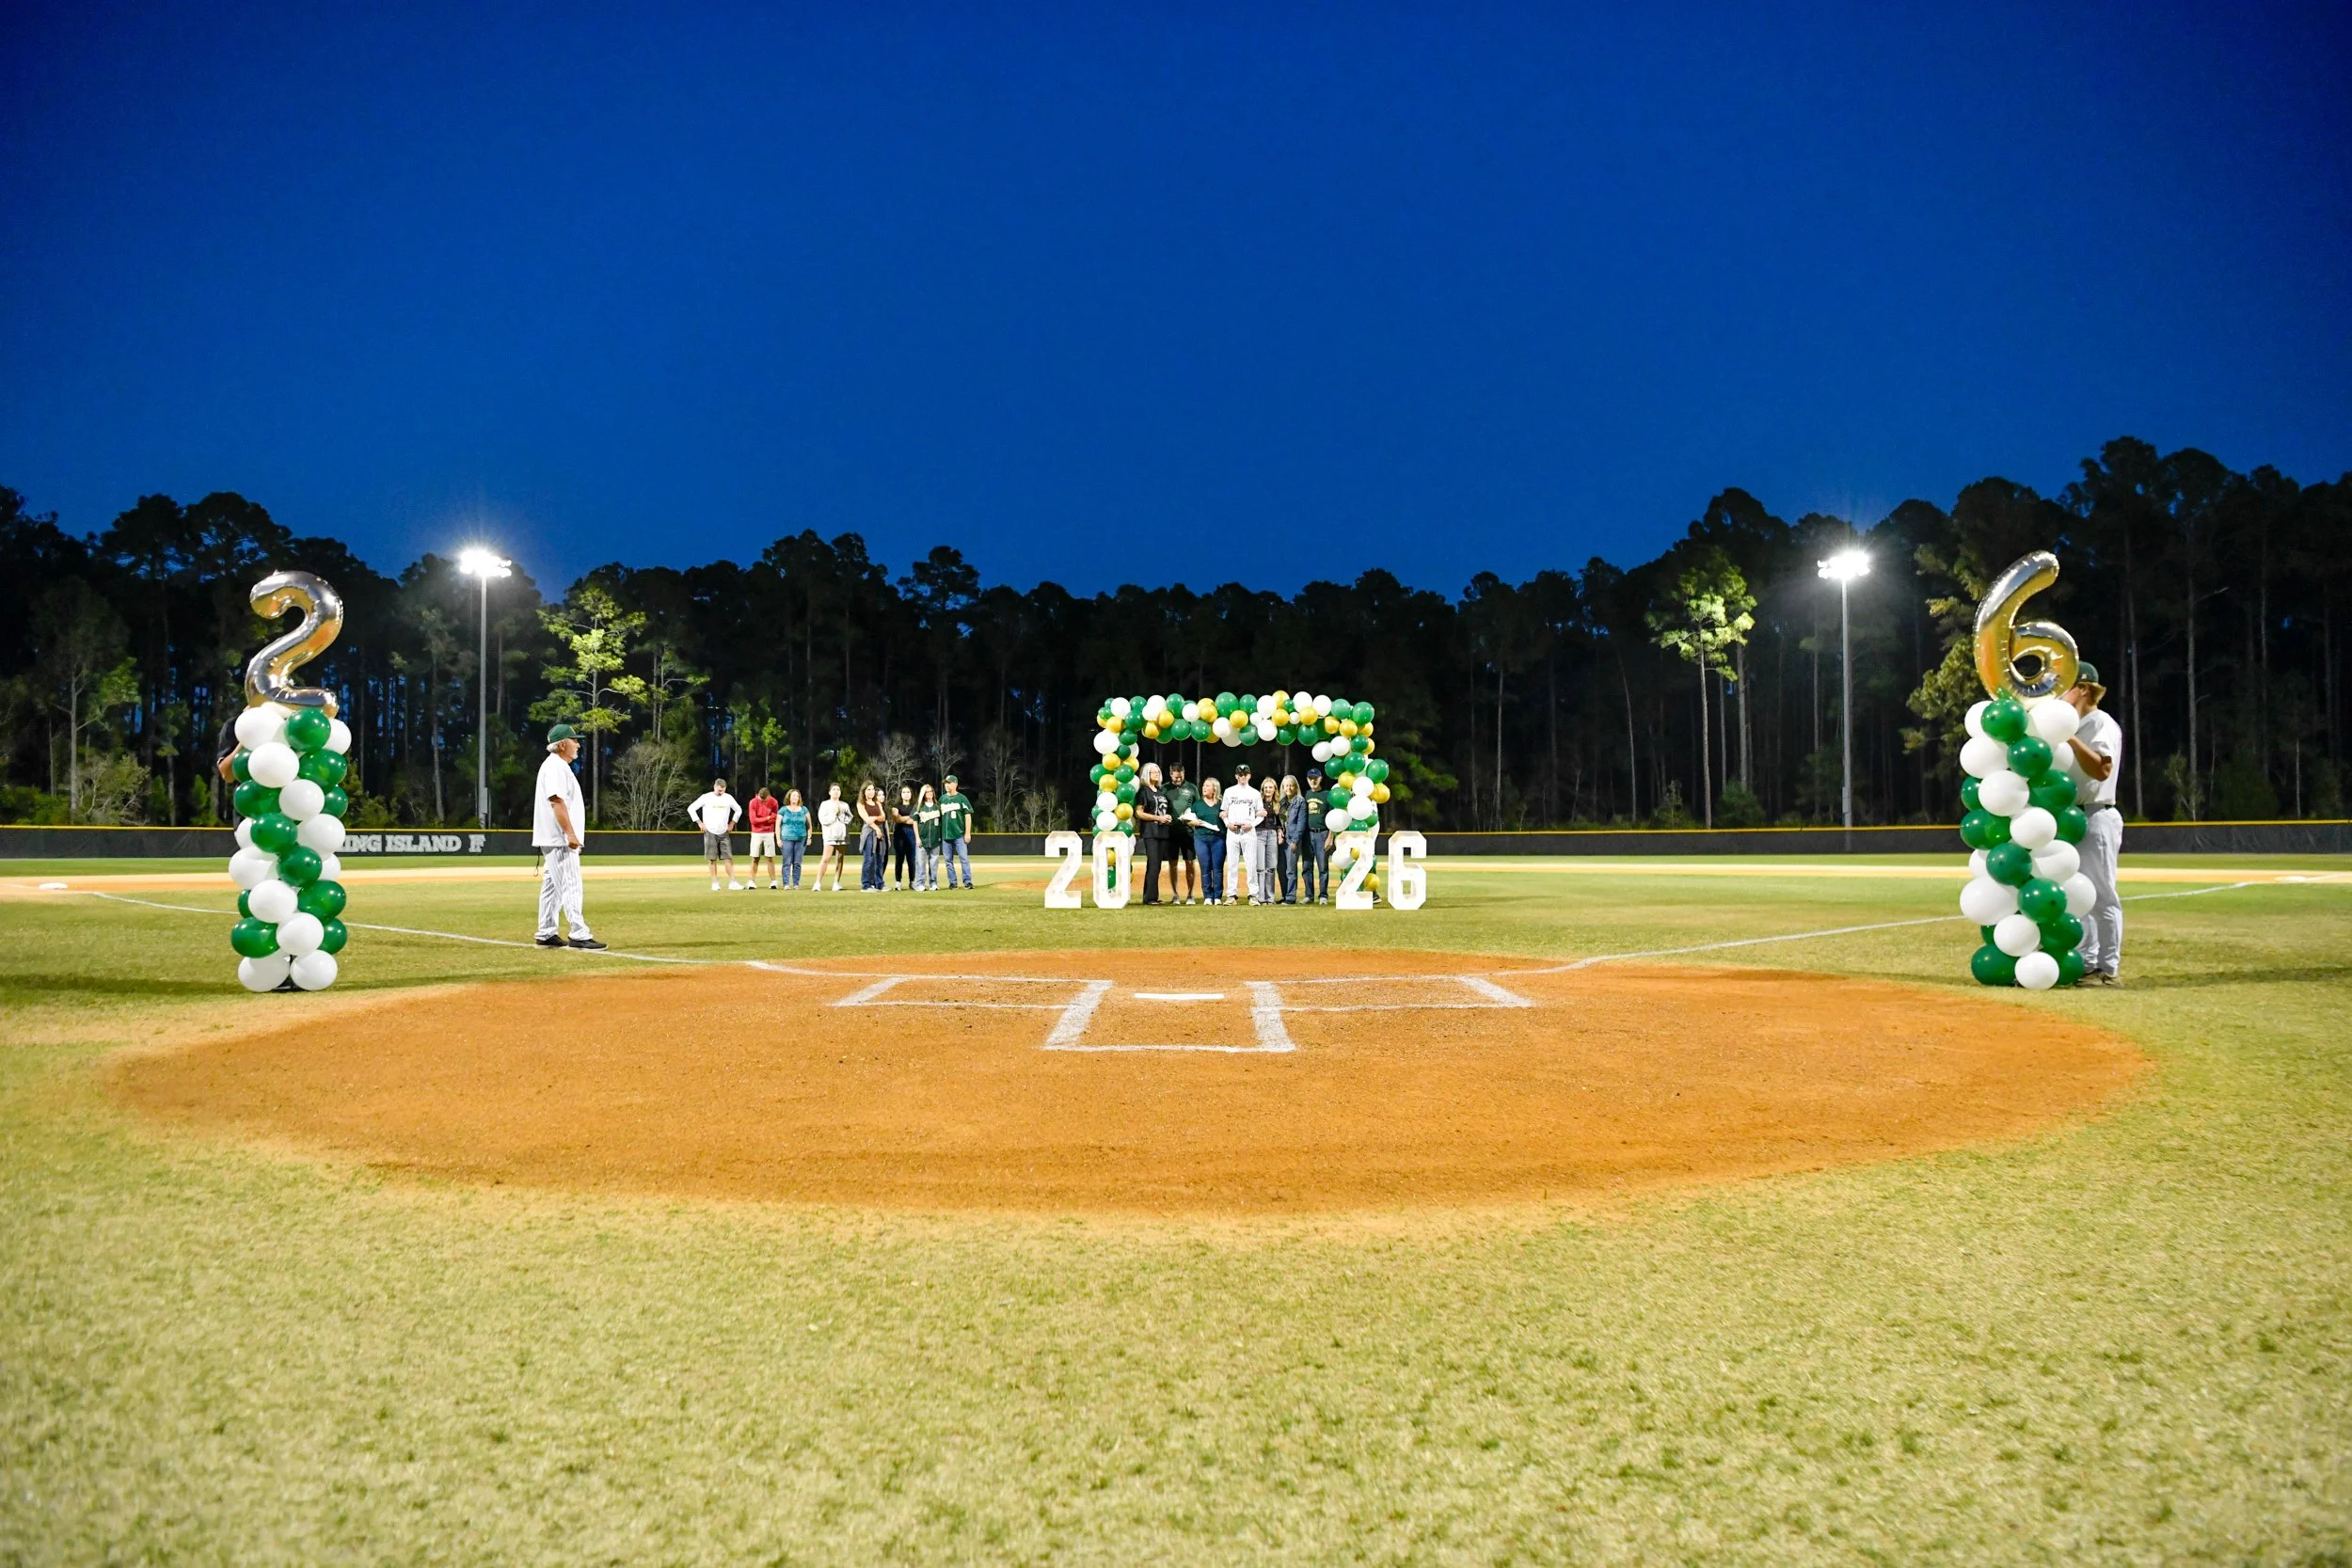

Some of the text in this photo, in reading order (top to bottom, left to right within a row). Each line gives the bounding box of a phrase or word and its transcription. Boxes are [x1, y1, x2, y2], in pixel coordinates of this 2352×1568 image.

[245, 570, 343, 718] 2
[1973, 550, 2079, 700] 6
[1228, 797, 1253, 807] Fleming
[385, 834, 462, 853] ISLAND
[1044, 831, 1427, 911] 20 26
